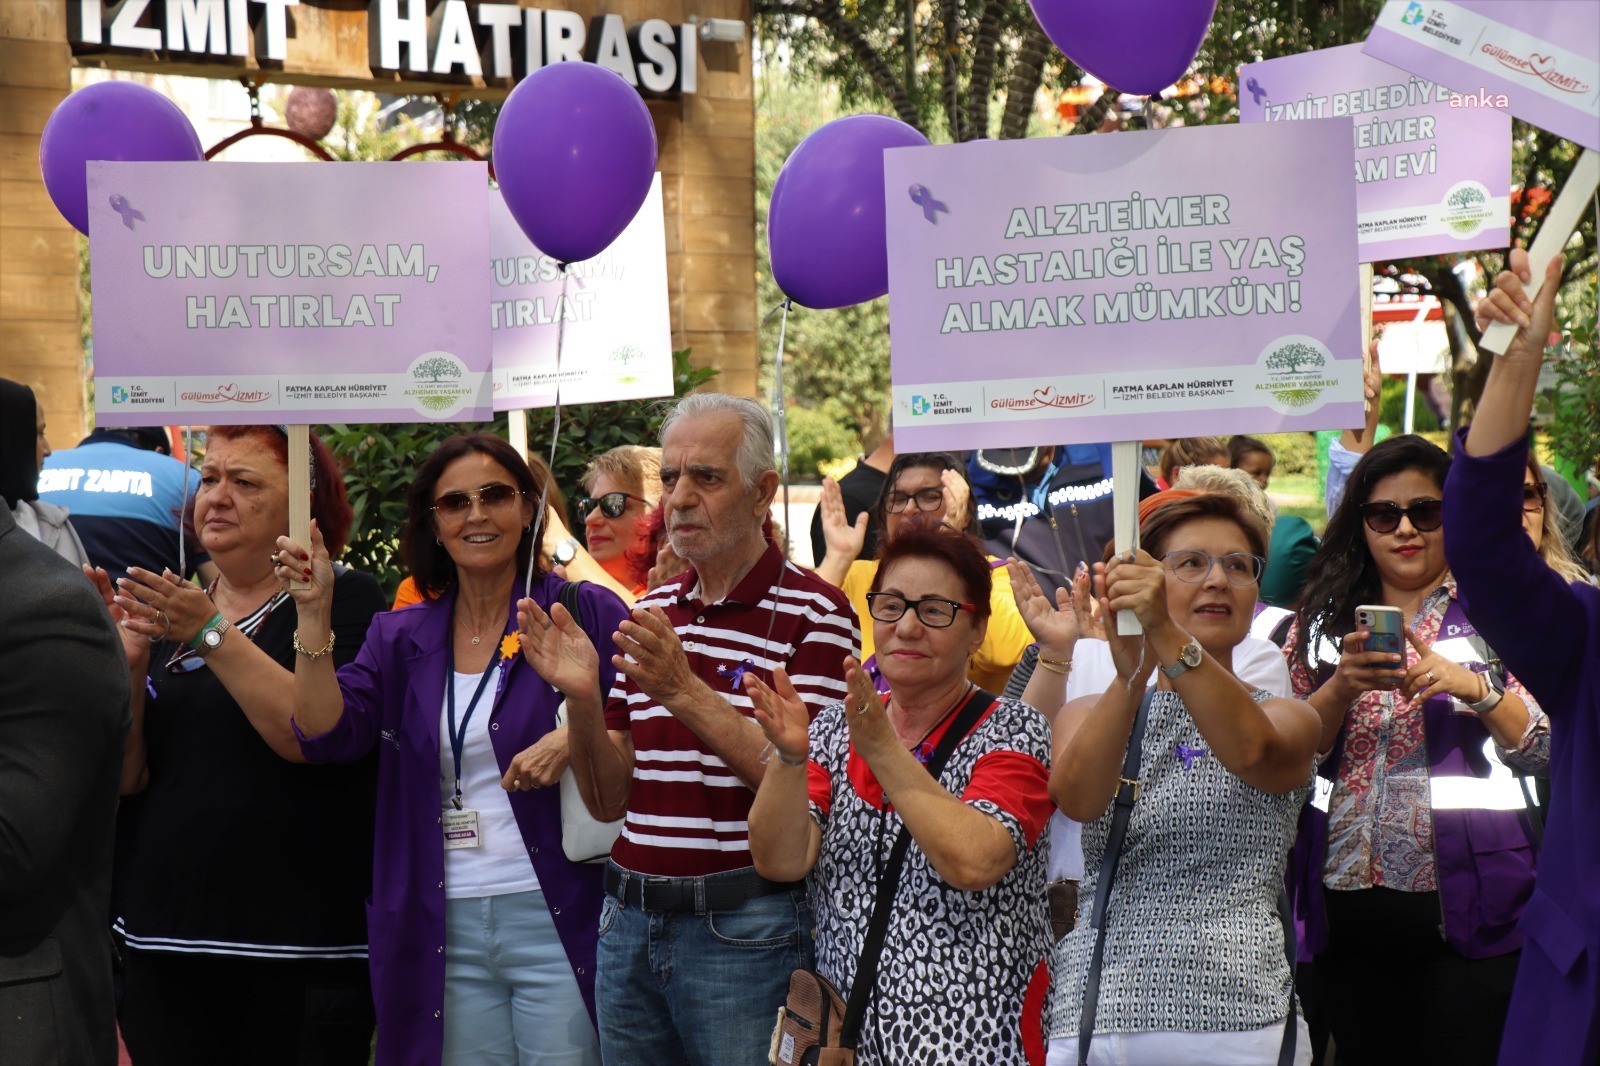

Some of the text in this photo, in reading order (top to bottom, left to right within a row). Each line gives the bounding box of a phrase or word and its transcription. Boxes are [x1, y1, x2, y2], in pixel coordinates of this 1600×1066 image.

[1430, 9, 1445, 20] T.C.
[1422, 25, 1463, 46] BELEDİYESİ
[380, 0, 697, 94] HATIRASI
[1481, 43, 1582, 90] Gülümse İZMİT
[1394, 144, 1437, 179] EVİ
[1004, 191, 1231, 239] ALZHEİMER
[1374, 219, 1398, 227] KAPLAN
[142, 244, 440, 283] UNUTURSAM,
[491, 249, 625, 287] URSAM,
[935, 235, 1307, 289] HASTALIĞI İLE YAŞ
[186, 294, 401, 328] HATIRLAT
[491, 292, 597, 330] TIRLAT
[940, 276, 1302, 334] ALMAK MÜMKÜN!
[285, 383, 387, 393] FATMA KAPLAN HÜRRİYET
[1112, 379, 1234, 394] FATMA KAPLAN HÜRRİYET
[1146, 389, 1185, 400] BELEDİYE
[1255, 378, 1339, 390] ALZHEİMER YAŞAM EVİ
[180, 390, 264, 401] Gülümse İZMİT
[314, 391, 348, 399] BELEDİYE
[990, 393, 1087, 409] Gülümse İZMİT
[933, 407, 972, 415] BELEDİYESİ
